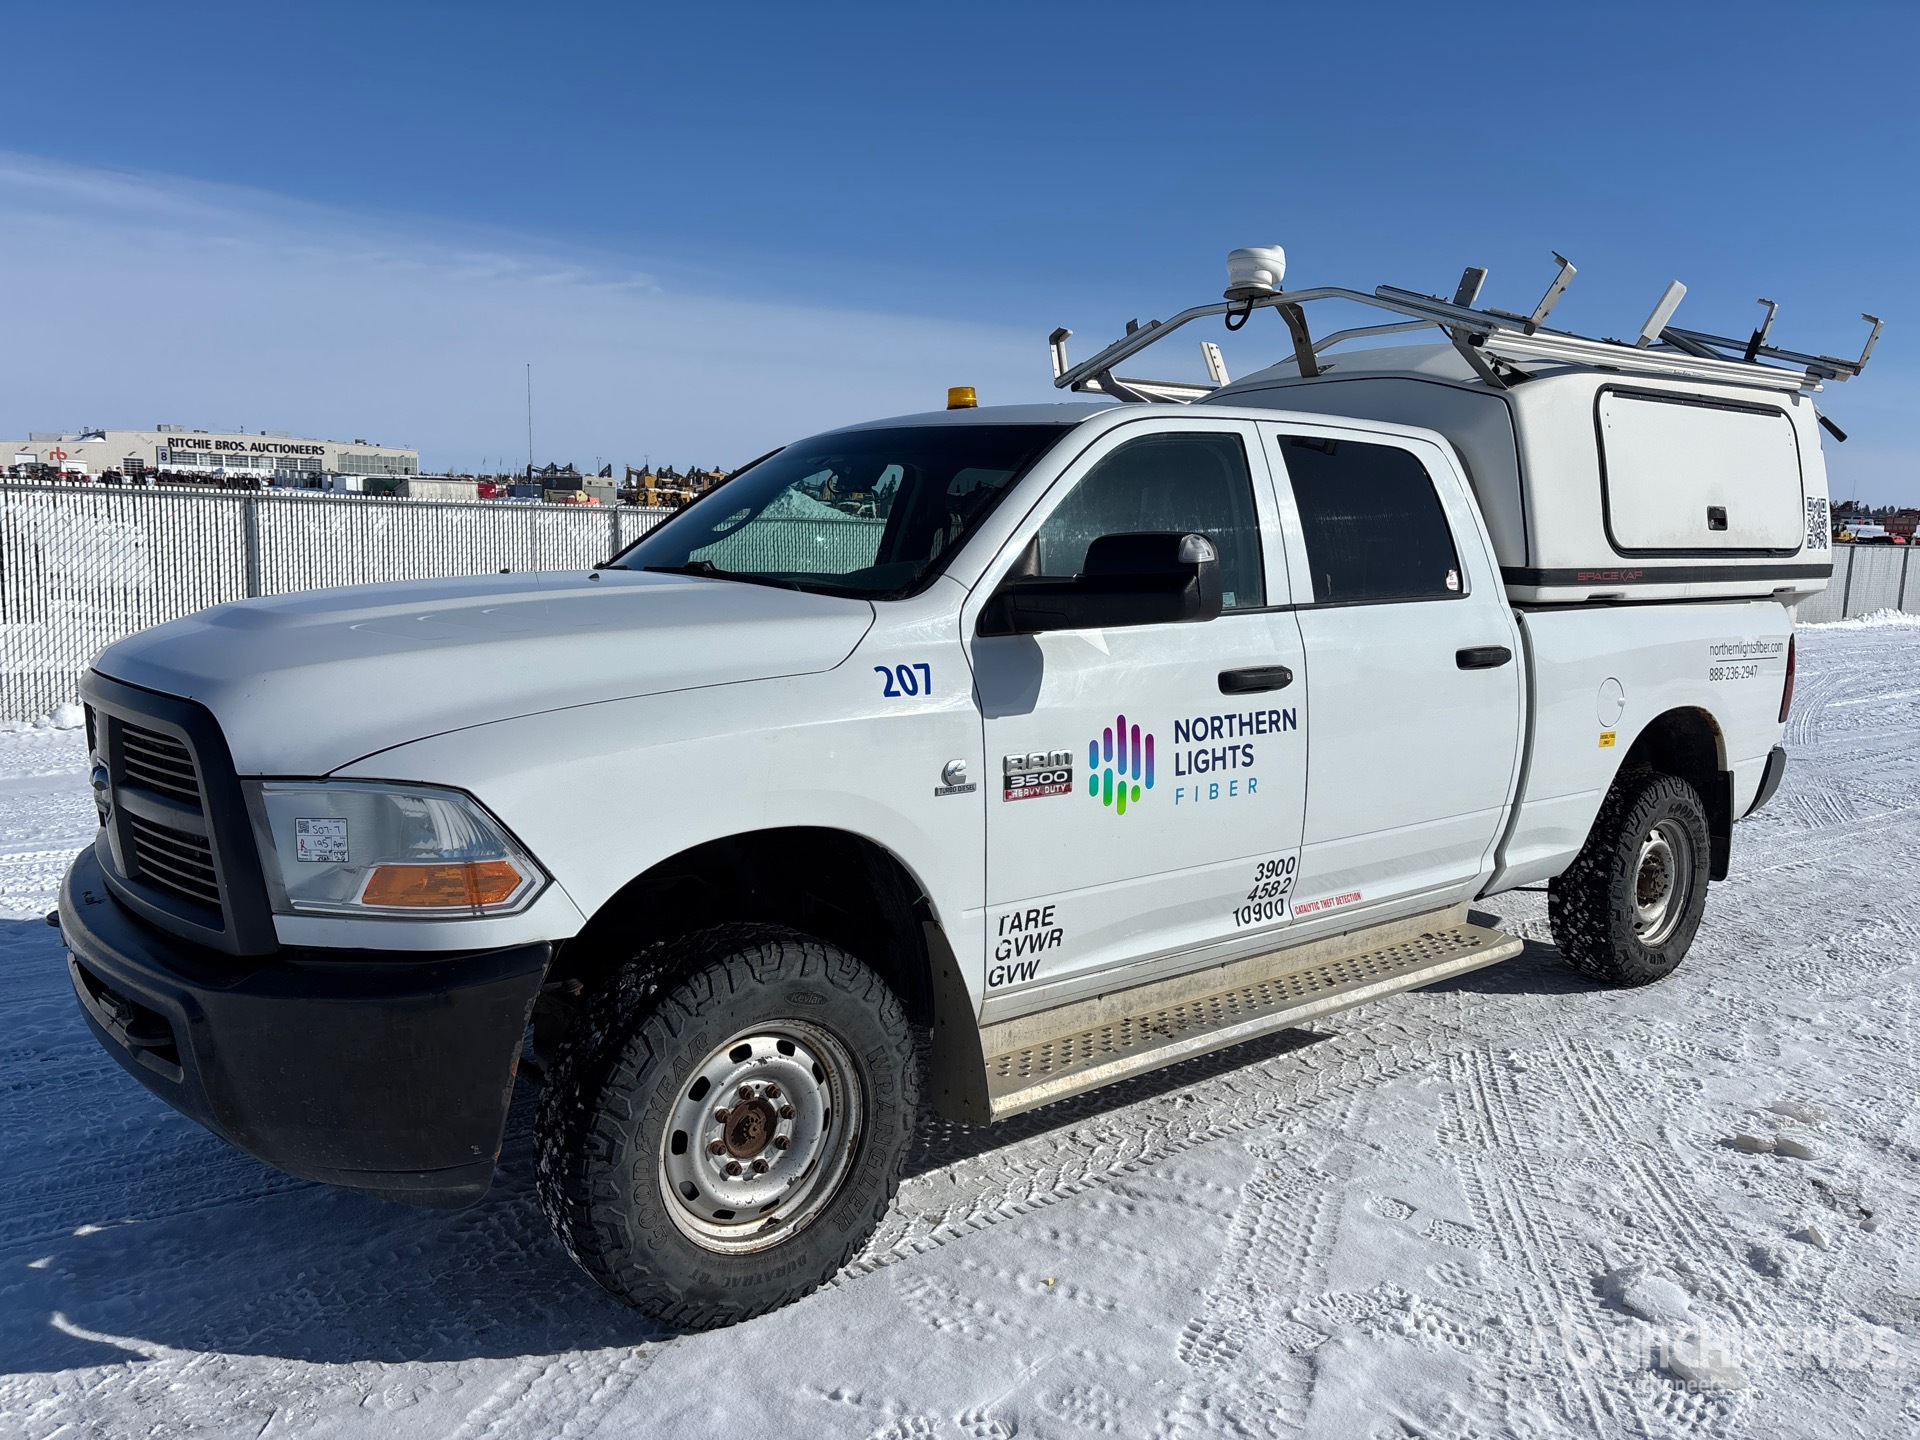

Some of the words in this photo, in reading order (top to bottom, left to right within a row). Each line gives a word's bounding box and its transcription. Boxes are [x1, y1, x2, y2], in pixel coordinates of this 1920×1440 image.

[160, 451, 168, 462] 8
[167, 437, 212, 450] RITCHIE
[215, 441, 248, 452] BROS.
[250, 442, 325, 456] AUCTIONEERS
[1709, 640, 1784, 658] northernlightsfiber.com
[873, 663, 932, 698] 207
[1708, 665, 1758, 682] 888-236-2947
[1174, 707, 1297, 744] NORTHERN
[1002, 749, 1074, 775] RAM
[1175, 743, 1255, 776] LIGHTS
[957, 784, 976, 793] DIESEL
[1009, 787, 1042, 800] HEAVY
[1044, 783, 1069, 795] DUTY
[1010, 770, 1068, 789] 3500
[1175, 777, 1258, 806] FIBER
[1254, 856, 1296, 882] 3900
[1247, 877, 1292, 902] 4582
[1232, 898, 1285, 927] 10900
[1294, 901, 1320, 915] CATALYTIC
[1320, 897, 1336, 909] THEFT
[1335, 892, 1362, 906] DETECTION
[998, 904, 1056, 937] TARE
[995, 927, 1064, 962] GVWR
[988, 958, 1041, 988] GVW
[832, 1044, 897, 1234] WRANGLER
[720, 1252, 808, 1289] DURATRAC
